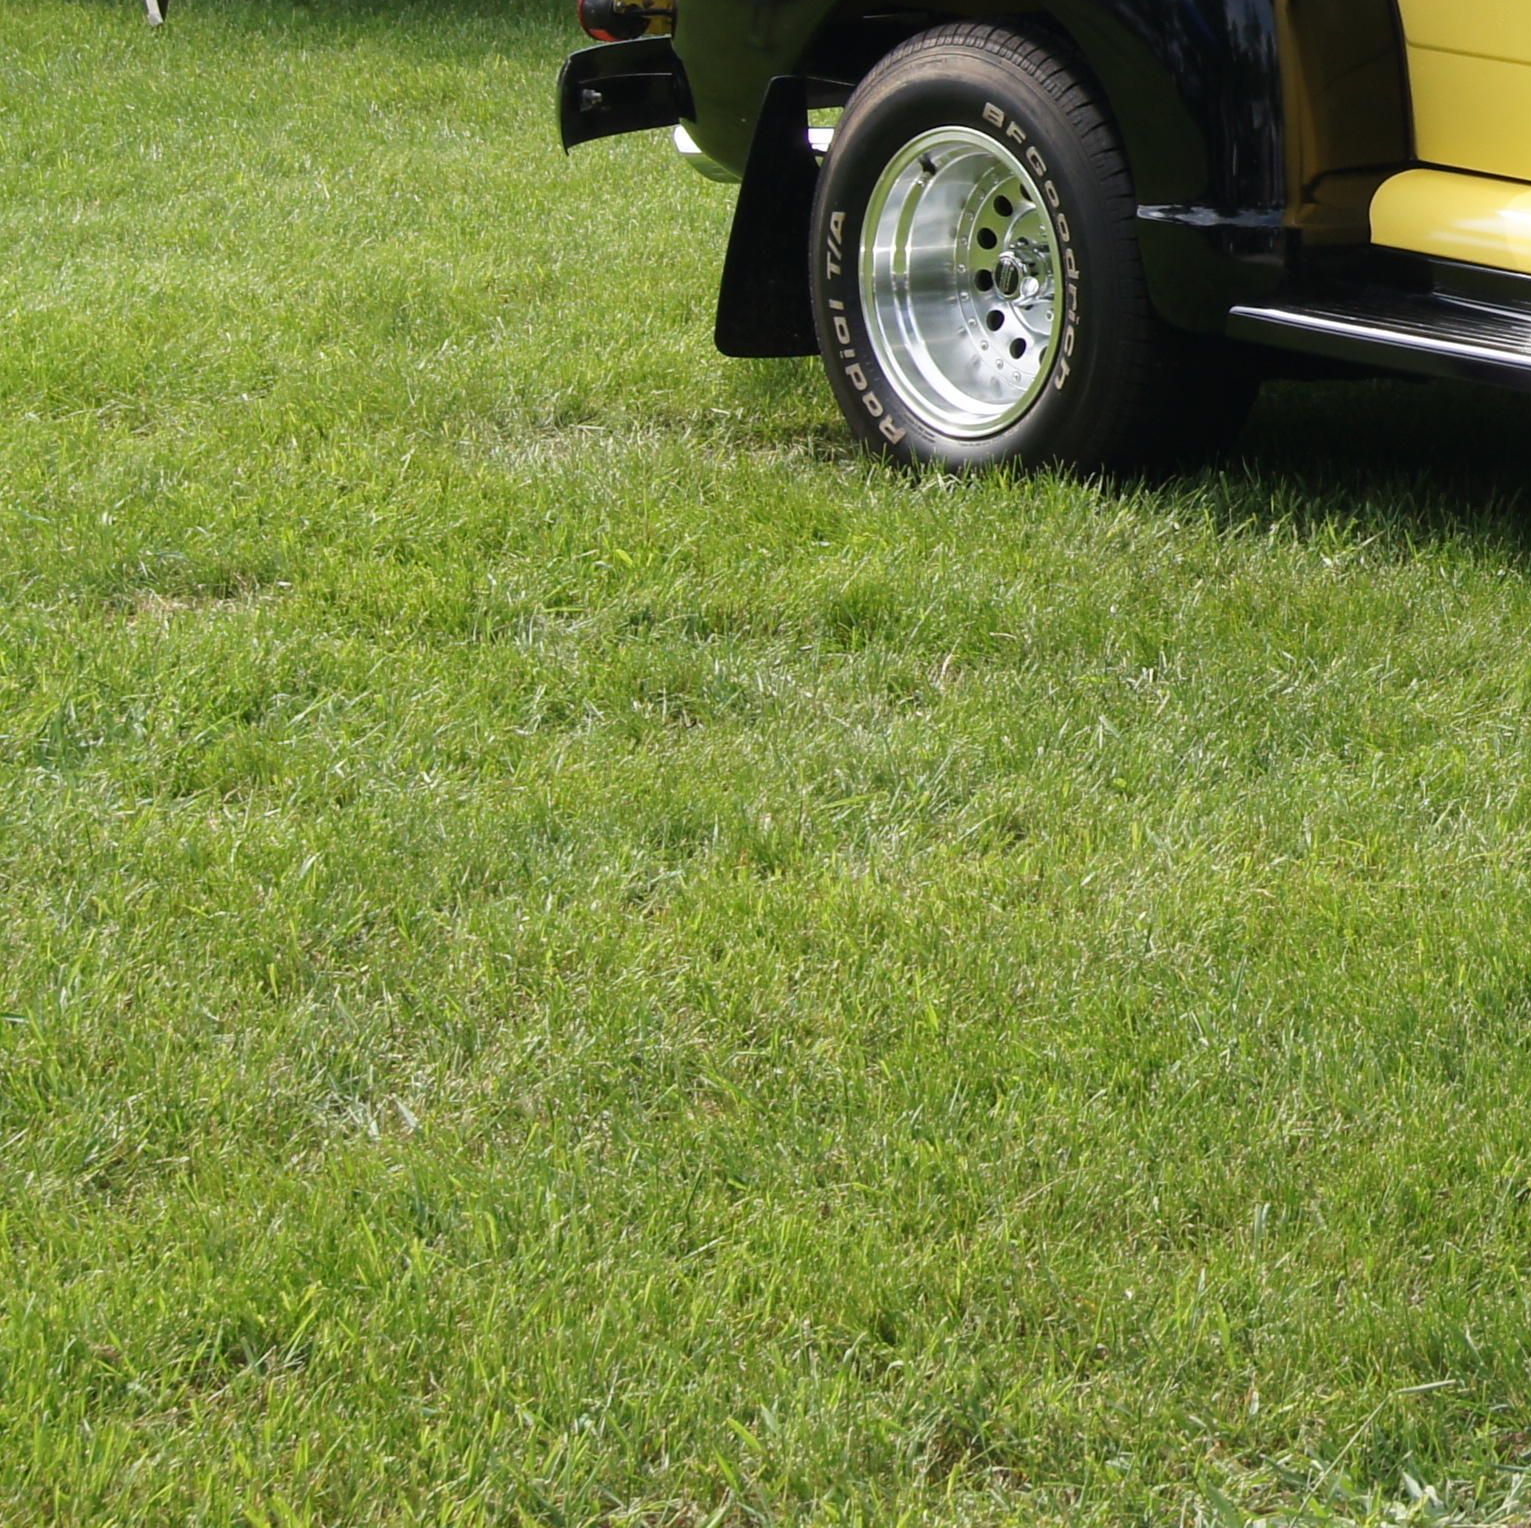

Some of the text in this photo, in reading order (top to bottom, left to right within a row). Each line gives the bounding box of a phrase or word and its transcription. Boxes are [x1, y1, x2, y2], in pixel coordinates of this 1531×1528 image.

[827, 211, 906, 446] Radial T/A
[982, 102, 1081, 390] BFGoodrich
